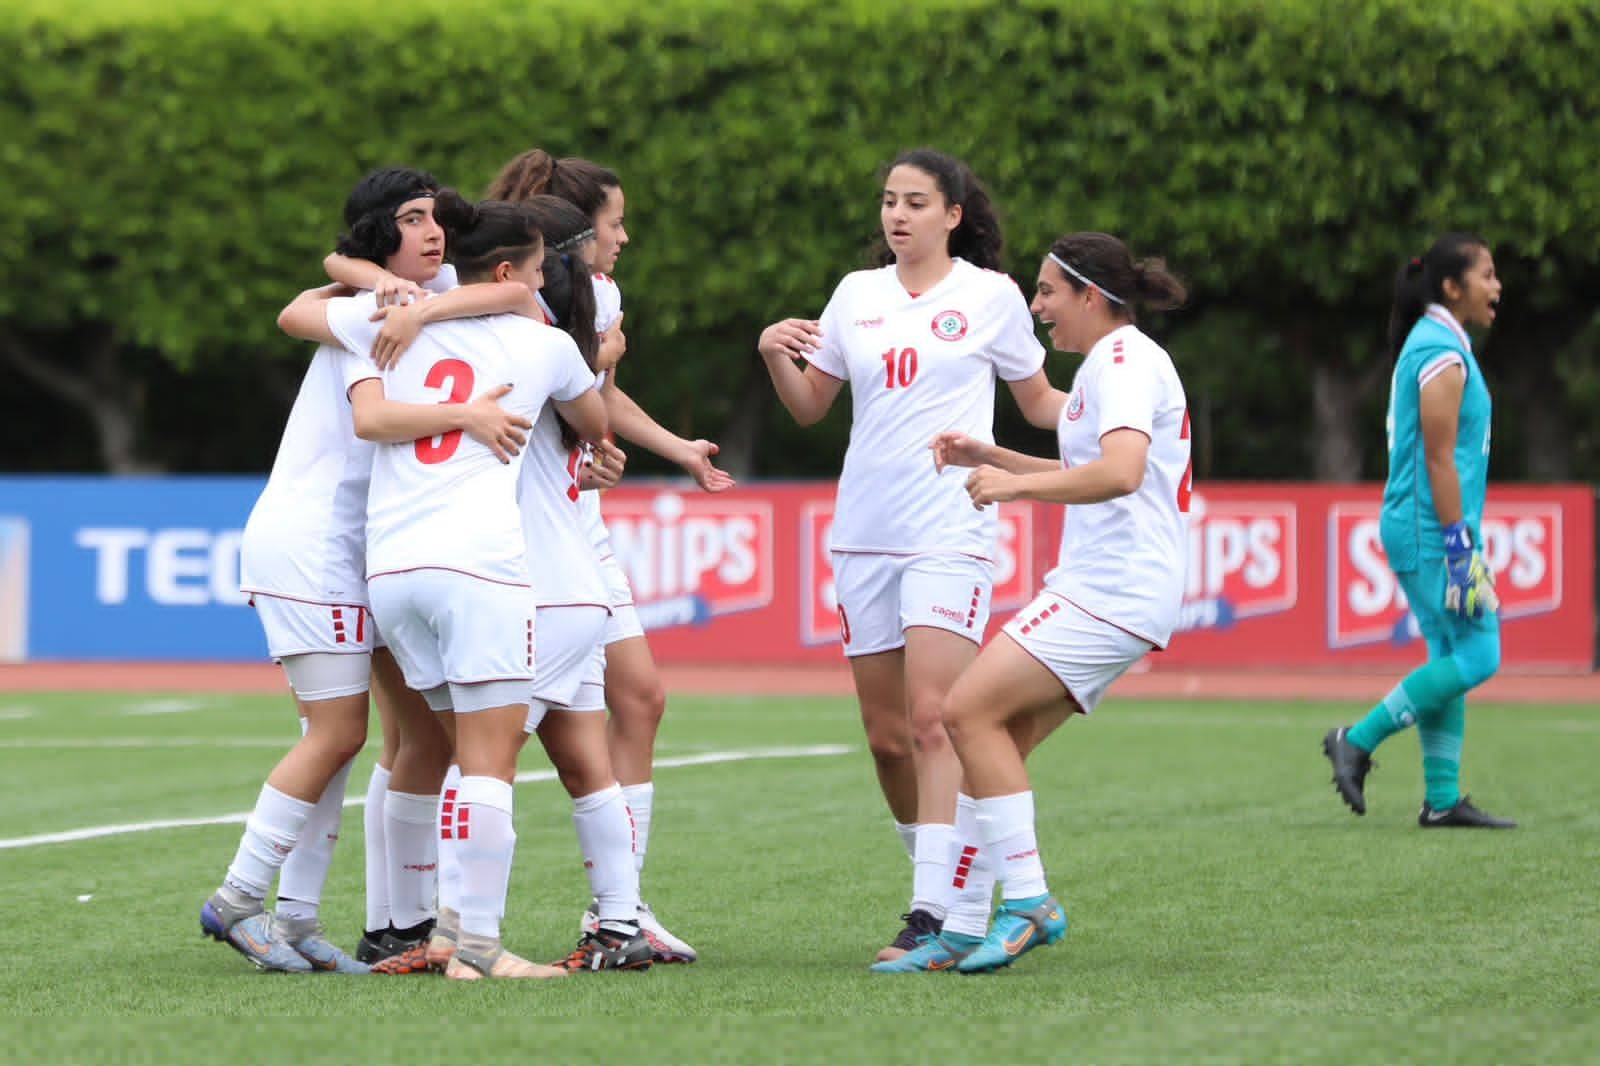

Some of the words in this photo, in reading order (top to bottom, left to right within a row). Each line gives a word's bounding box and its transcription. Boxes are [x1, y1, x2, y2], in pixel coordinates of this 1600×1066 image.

[414, 358, 475, 465] 3
[881, 347, 919, 389] 10
[609, 492, 758, 599] NiPS
[1183, 491, 1282, 599] iPS
